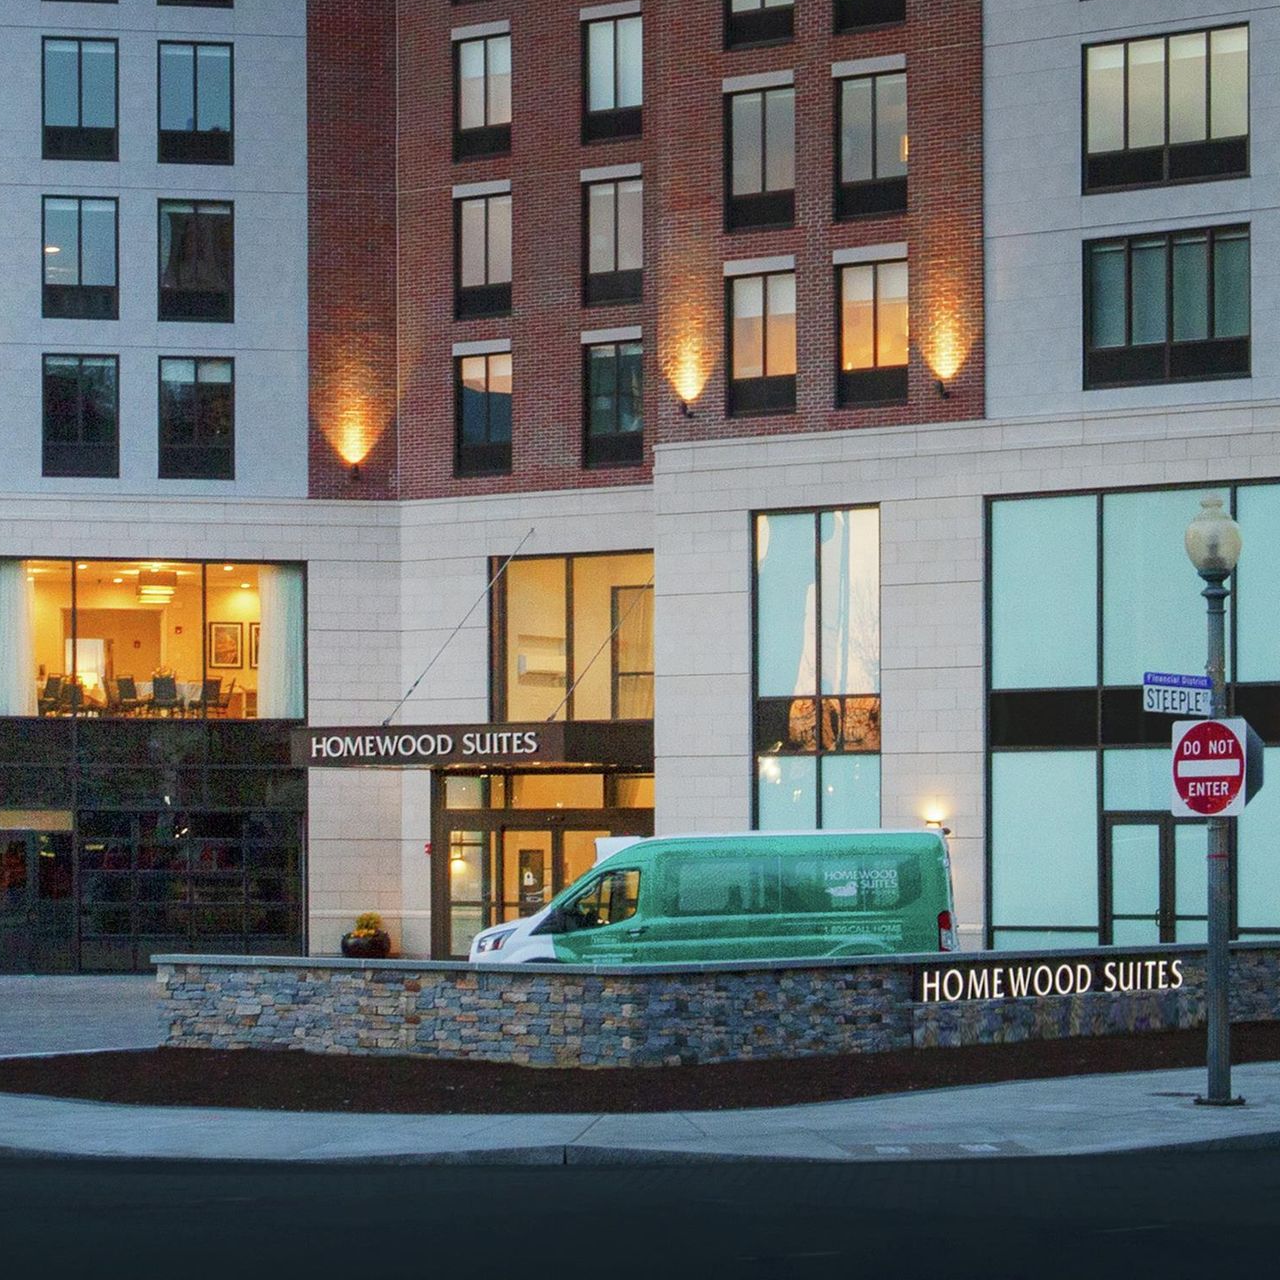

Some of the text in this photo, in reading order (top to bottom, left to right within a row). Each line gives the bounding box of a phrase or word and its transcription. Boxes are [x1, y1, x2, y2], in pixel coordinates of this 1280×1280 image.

[1147, 688, 1202, 712] STEEPLE
[311, 731, 538, 758] HOMEWOOD SUITES
[1183, 739, 1234, 755] DO NOT
[1188, 781, 1229, 797] ENTER
[824, 869, 898, 881] HOMEWOOD
[861, 880, 898, 890] SUITES
[922, 959, 1184, 1003] HOMEWOOD SUITES
